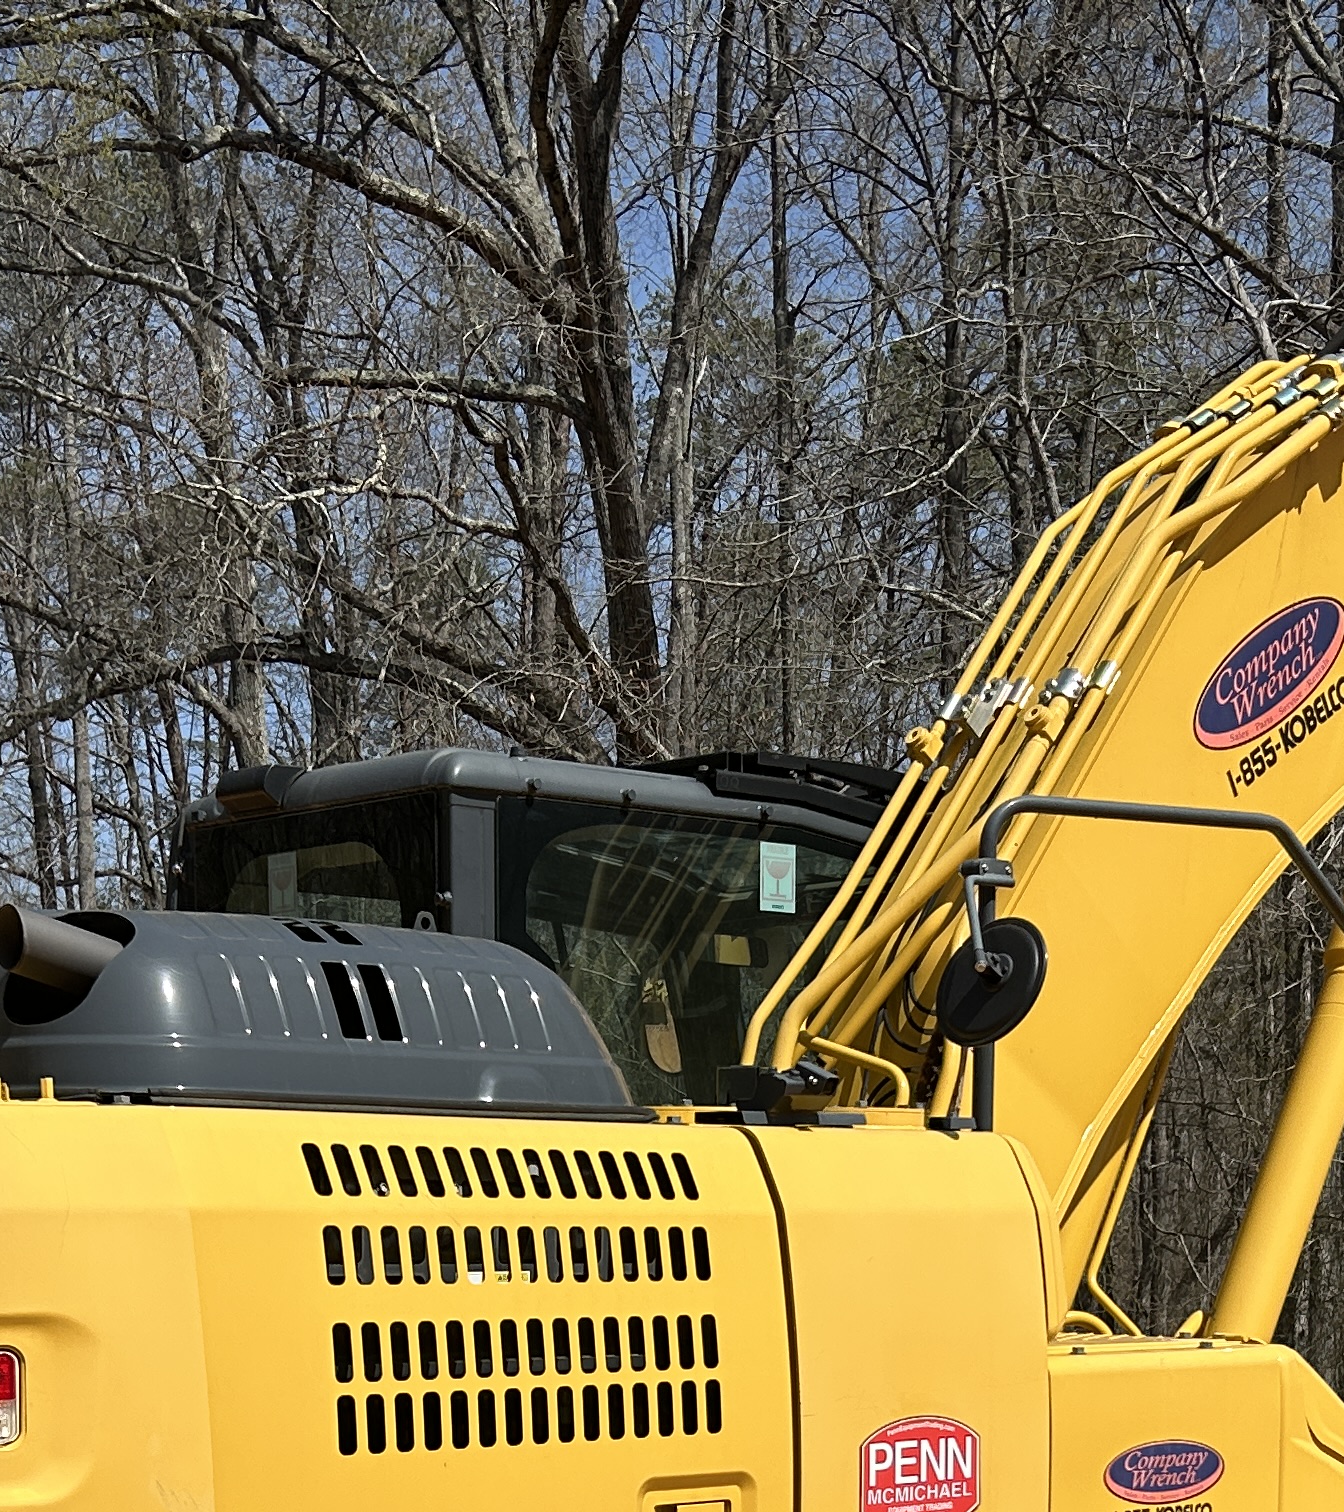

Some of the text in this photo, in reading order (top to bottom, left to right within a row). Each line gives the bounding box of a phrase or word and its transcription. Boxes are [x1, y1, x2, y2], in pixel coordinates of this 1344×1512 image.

[1215, 607, 1320, 705] Company
[1230, 638, 1317, 725] Wrench
[868, 1436, 973, 1487] PENN
[1124, 1450, 1209, 1473] Company
[1132, 1466, 1198, 1490] Wrench
[867, 1481, 973, 1506] MCMICHAEL
